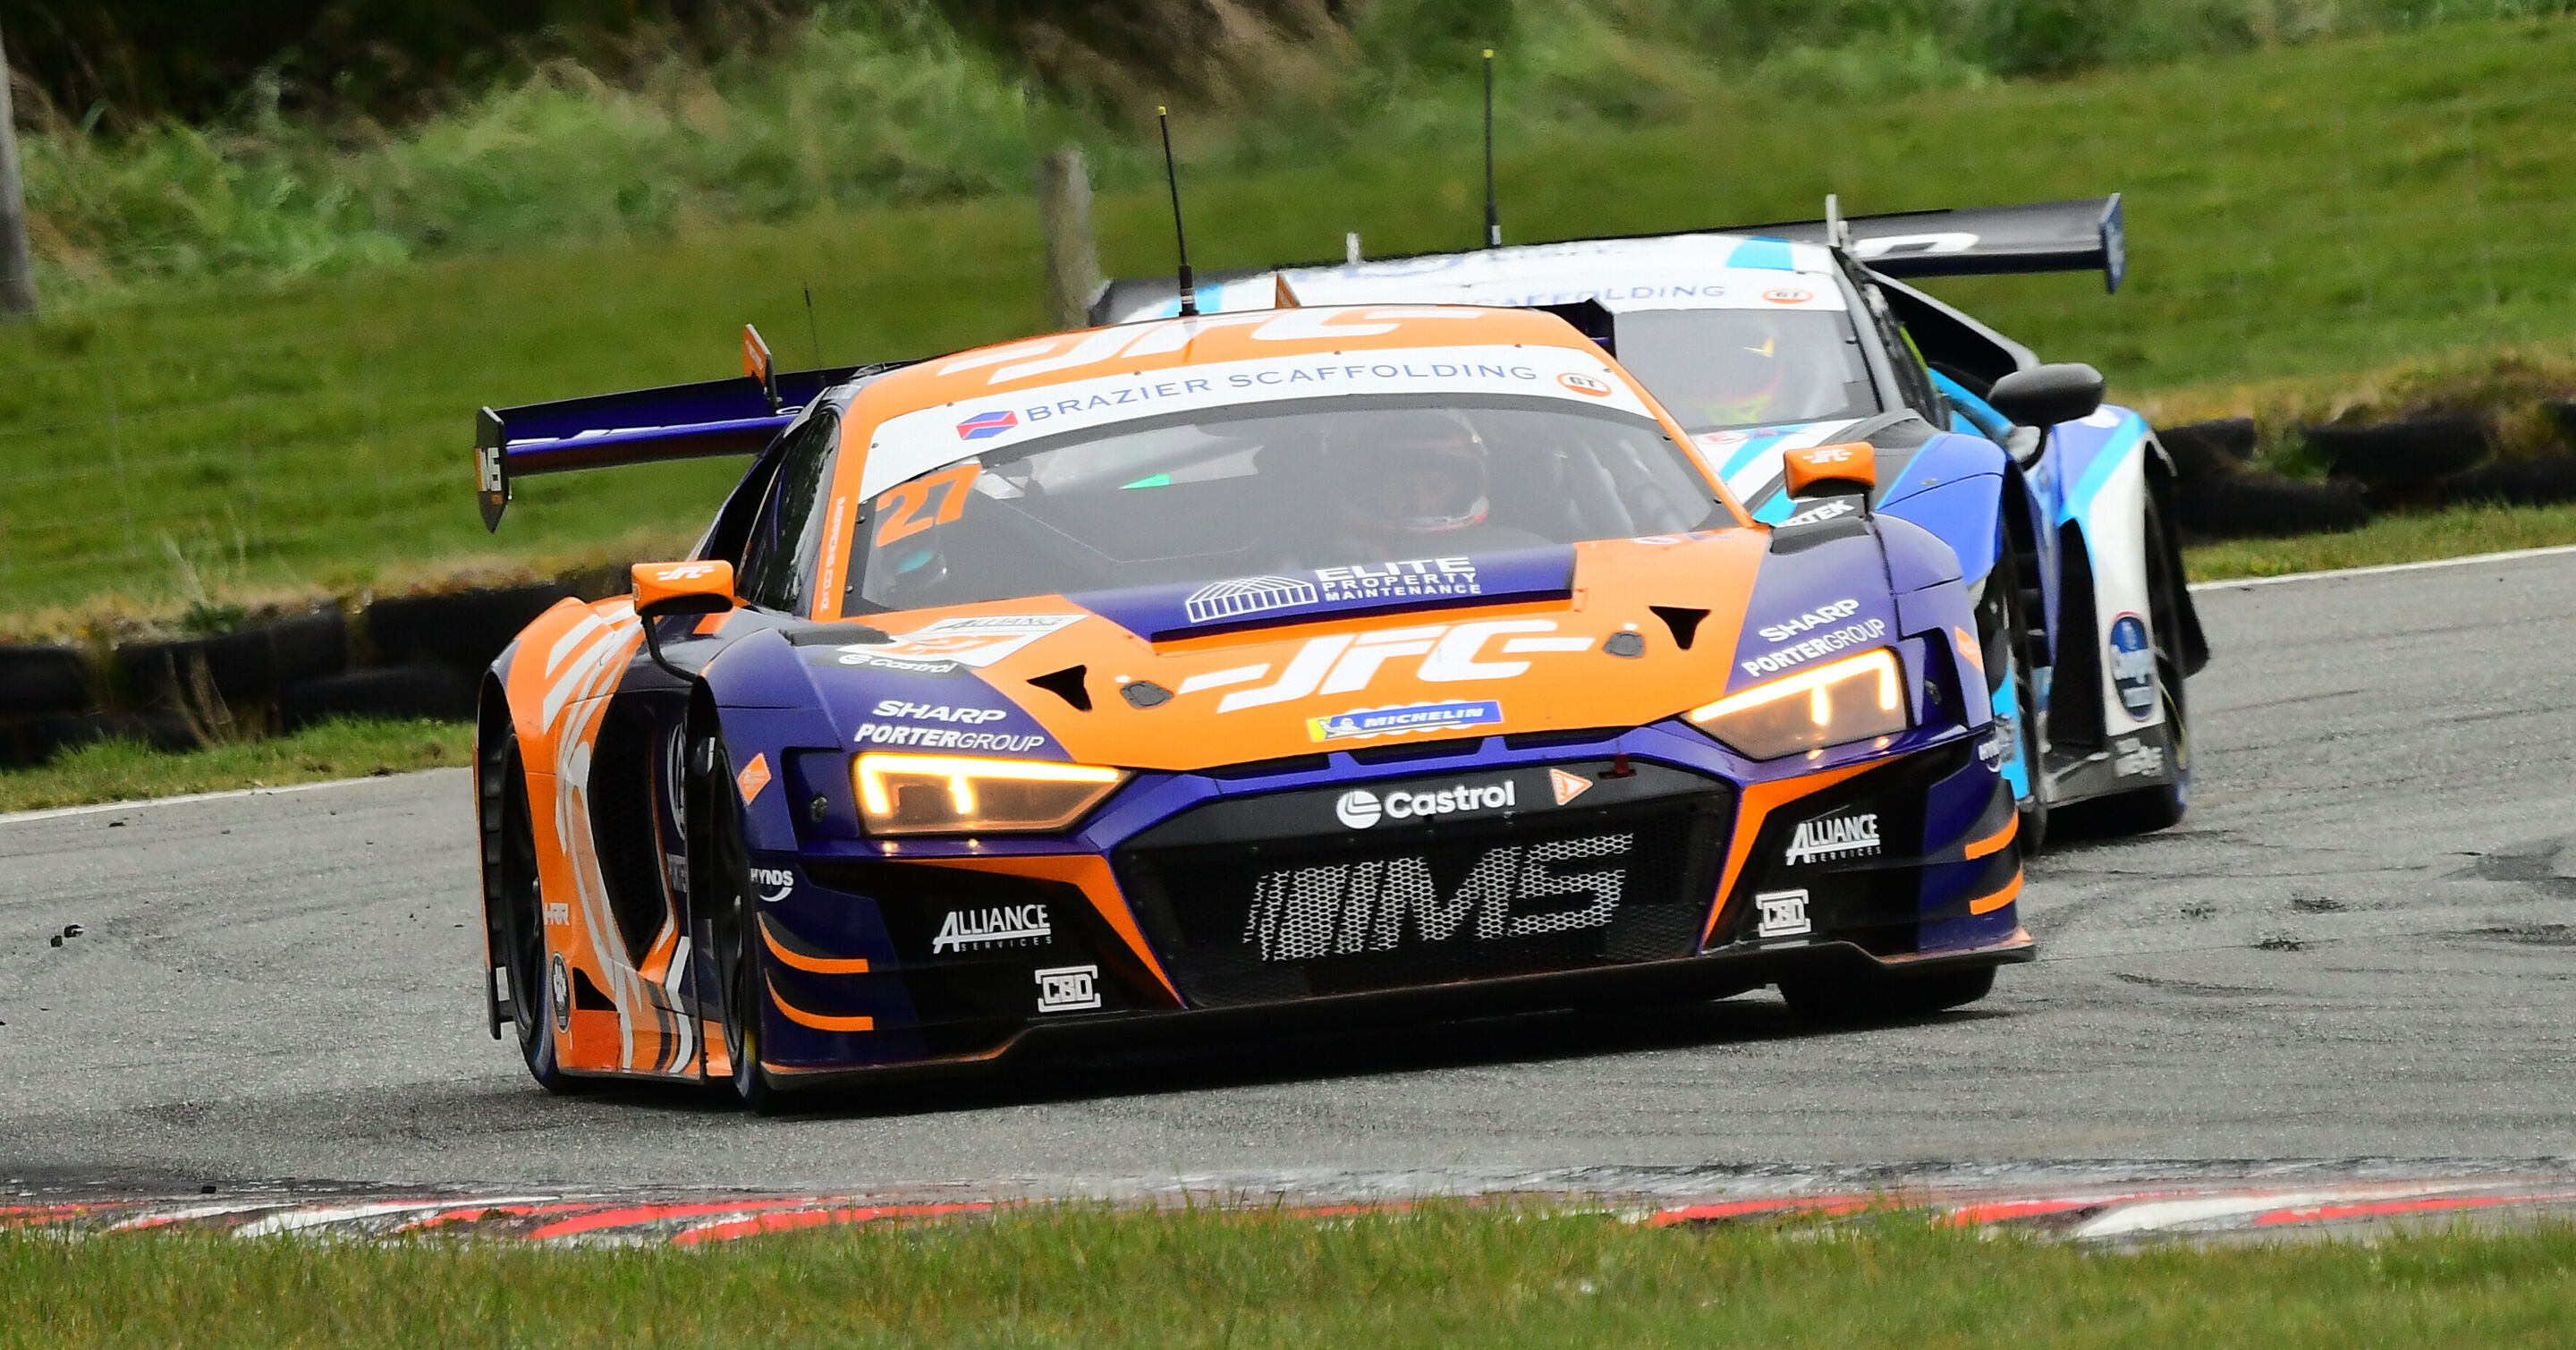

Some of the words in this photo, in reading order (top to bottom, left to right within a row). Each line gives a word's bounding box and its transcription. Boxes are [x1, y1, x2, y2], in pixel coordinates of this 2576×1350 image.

[1025, 378, 1208, 422] BRAZIER
[1228, 361, 1538, 387] SCAFFOLDING
[876, 463, 982, 548] 27
[1315, 556, 1476, 582] ELITE
[1322, 573, 1477, 591] PROPERTY
[1325, 583, 1481, 602] MAINTENANCE
[1758, 599, 1860, 642] SHARP
[1741, 618, 1885, 677] PORTERGROUP
[869, 656, 961, 673] Castrol
[872, 700, 1007, 725] SHARP
[1362, 708, 1485, 728] MICHELIN
[853, 723, 1045, 752] PORTERGROUP
[1385, 780, 1516, 819] Castrol
[1785, 813, 1881, 866] ALLIANCE
[1811, 846, 1882, 863] SERVICES
[750, 867, 794, 886] HYNDS
[933, 904, 1052, 954] ALLIANCE
[961, 936, 1053, 952] SERVICES
